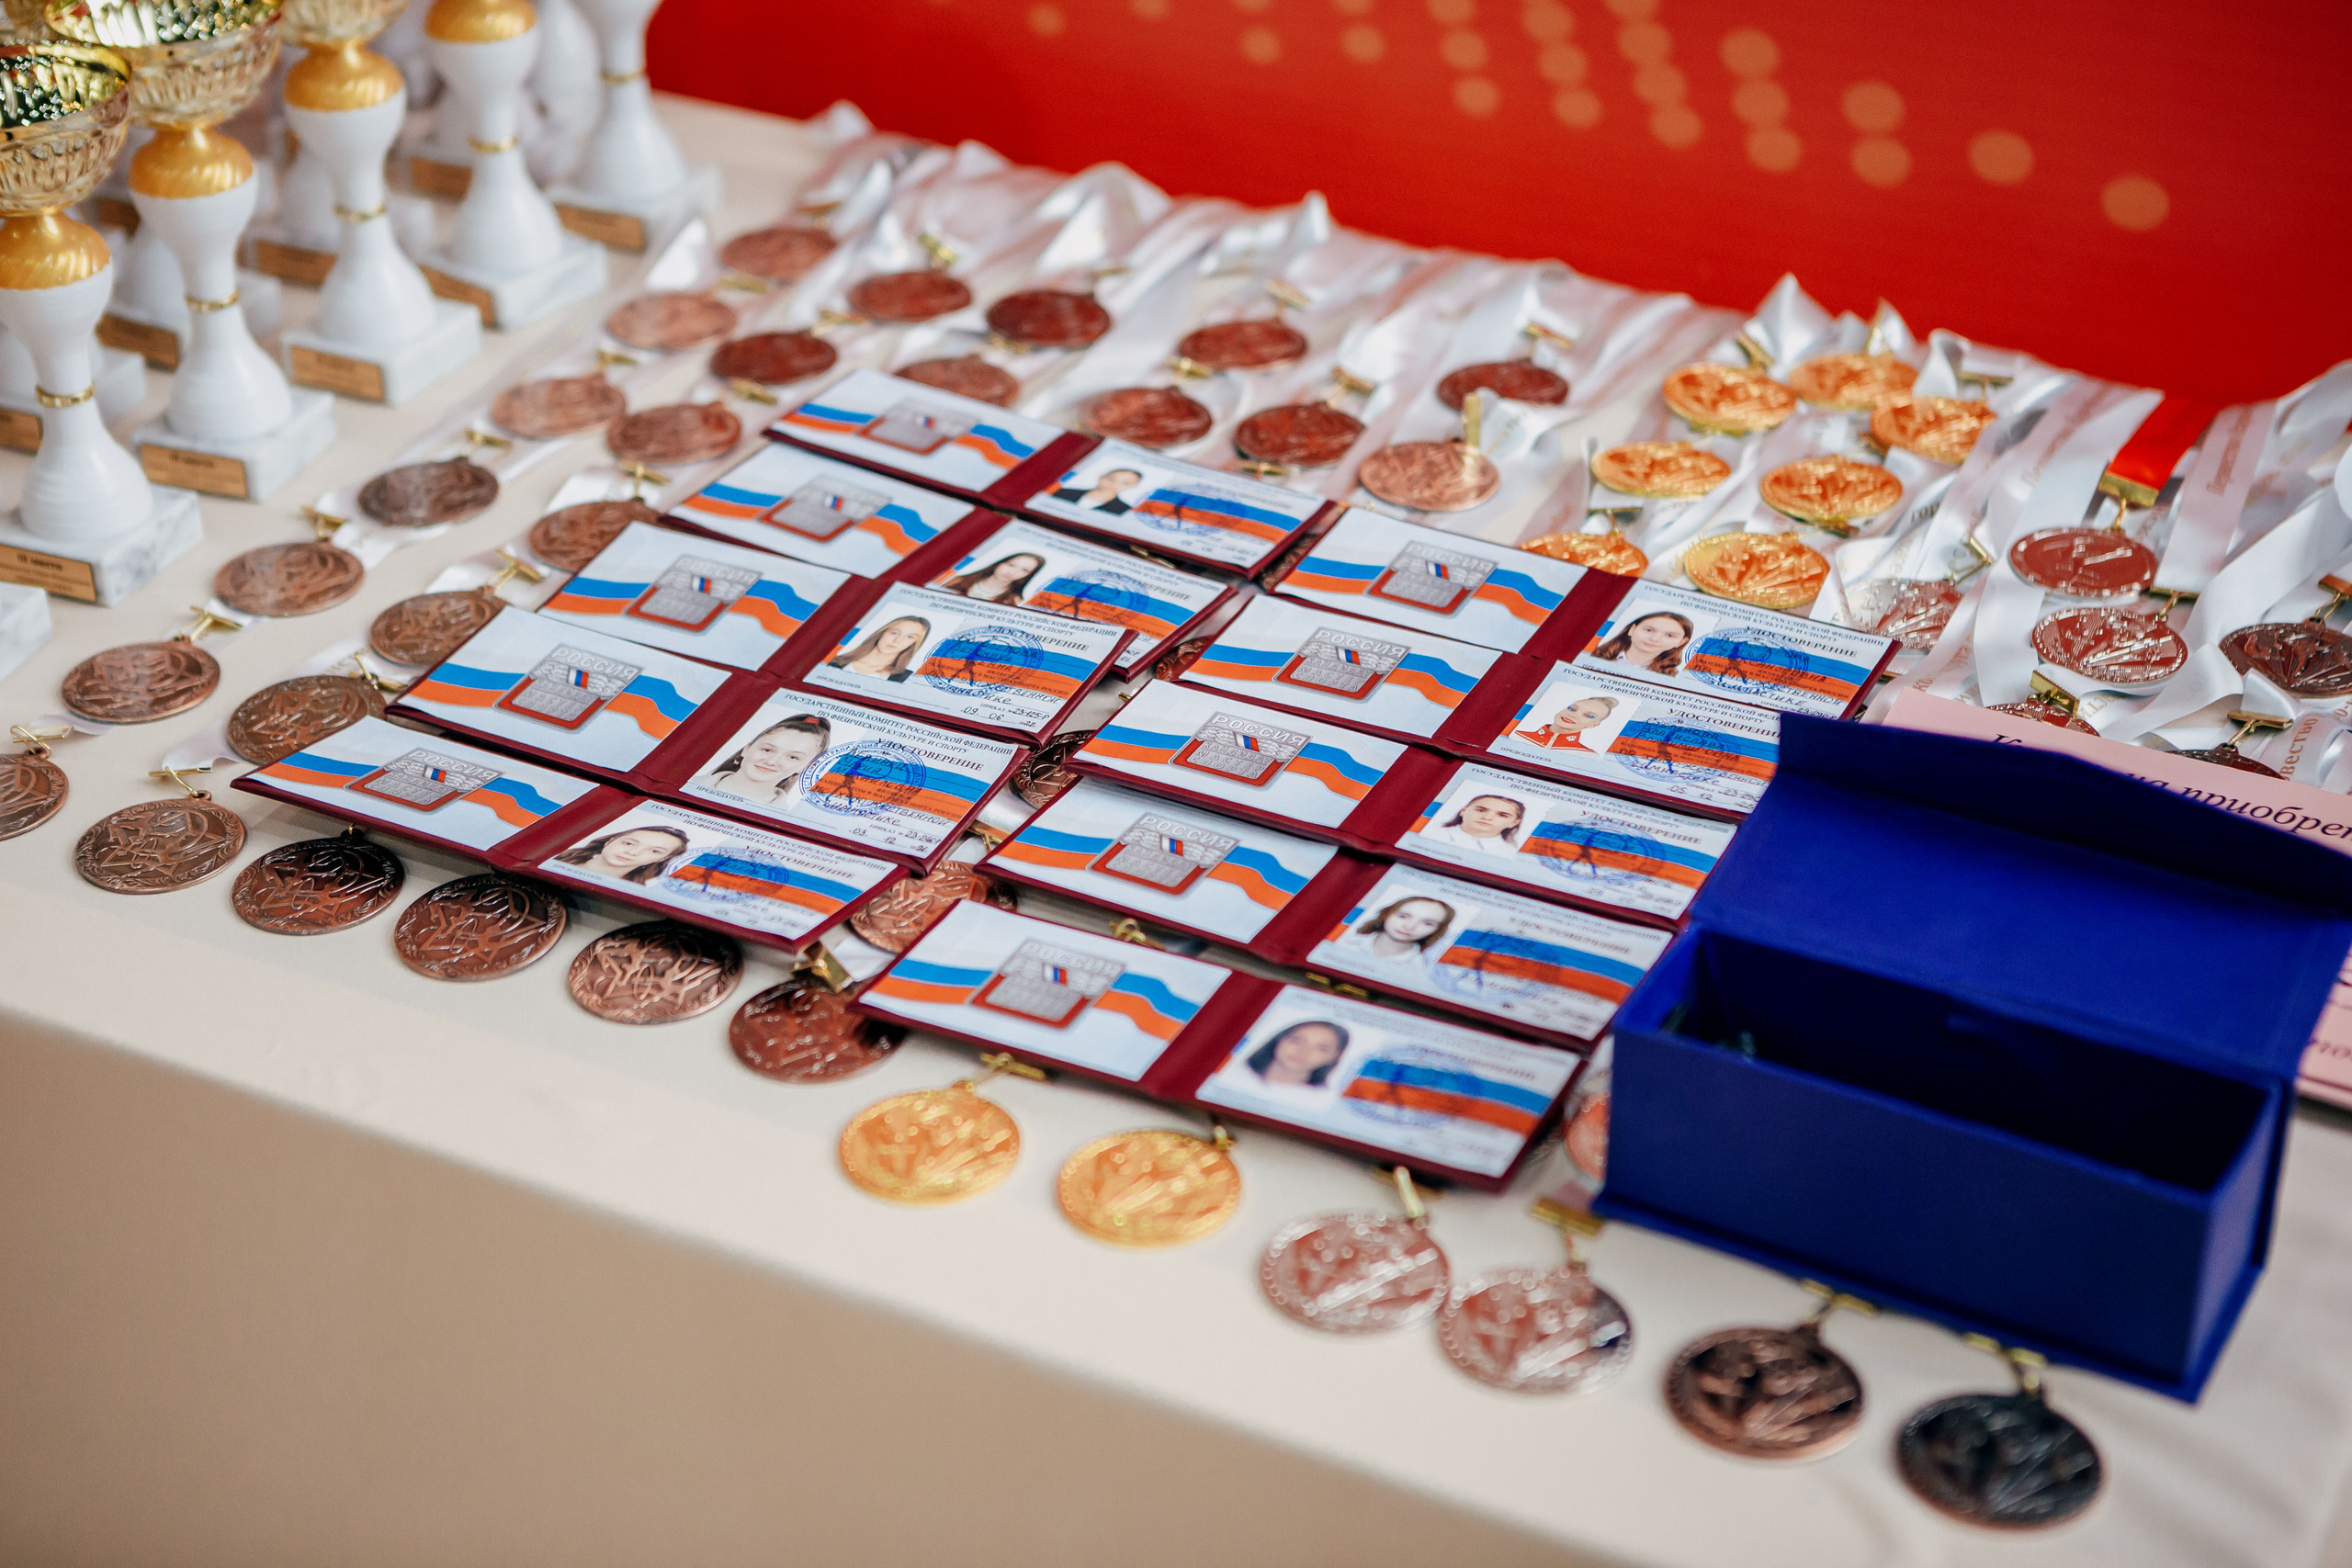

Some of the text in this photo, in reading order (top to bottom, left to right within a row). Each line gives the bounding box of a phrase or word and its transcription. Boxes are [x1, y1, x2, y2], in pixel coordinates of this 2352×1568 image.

[1407, 544, 1493, 572] РОССИЯ
[897, 589, 1118, 637] ГОСУДАРСТВЕННЫЙ КОМИТЕТ РОССИЙСКОЙ ФЕДЕРАЦИИ
[941, 604, 996, 620] ФИЗИЧЕСКОЙ
[994, 615, 1036, 628] КУЛЬТУРЕ
[1042, 626, 1075, 637] СПОРТУ
[1728, 606, 1770, 619] КОМИТЕТ
[1770, 615, 1831, 634] РОССИЙСКОЙ
[1829, 629, 1884, 647] ФЕДЕРАЦИИ
[983, 625, 1091, 651] УДОСТОВЕРЕНИЕ
[1314, 630, 1407, 658] РОССИЯ
[1743, 626, 1858, 658] УДОСТОВЕРЕНИЕ
[1802, 630, 1839, 643] СПОРТУ
[551, 647, 639, 681] РОССИЯ
[1298, 665, 1365, 684] МАСТЕР
[1306, 657, 1372, 677] КАНДИДАТ
[1293, 672, 1359, 693] СПОРТА
[1561, 669, 1650, 692] ГОСУДАРСТВЕННЫЙ
[1649, 688, 1693, 701] КОМИТЕТ
[1693, 698, 1757, 716] РОССИЙСКОЙ
[514, 697, 576, 721] СПОРТА
[523, 690, 589, 711] МАСТЕР
[1612, 687, 1675, 704] ФИЗИЧЕСКОЙ
[1674, 701, 1719, 714] КУЛЬТУРЕ
[1727, 712, 1765, 724] СПОРТУ
[783, 694, 1013, 756] ГОСУДАРСТВЕННЫЙ КОМИТЕТ РОССИЙСКОЙ ФЕДЕРАЦИИ
[828, 713, 888, 732] ФИЗИЧЕСКОЙ
[884, 728, 929, 743] КУЛЬТУРЕ
[933, 740, 970, 754] СПОРТУ
[1211, 715, 1307, 746] РОССИЯ
[1666, 707, 1783, 739] УДОСТОВЕРЕНИ
[872, 738, 985, 771] УДОСТОВЕРЕНИЕ
[1195, 750, 1266, 771] МАСТЕР
[1204, 741, 1274, 764] КАНДИДАТ
[1498, 747, 1554, 762] ПРЕДСЕДАТЕЛЬ
[2279, 717, 2318, 781] вество
[408, 750, 499, 781] РОССИЯ
[1191, 756, 1258, 779] СПОРТА
[368, 784, 431, 805] СПОРТА
[695, 785, 746, 803] ПРЕДСЕДАТЕЛЬ
[1469, 767, 1562, 793] ГОСУДАРСТВЕННЫЙ
[1561, 790, 1606, 804] КОМИТЕТ
[648, 804, 736, 829] ГОСУДАРСТВЕННЫЙ
[732, 827, 776, 841] КОМИТЕТ
[1138, 815, 1236, 851] РОССИЯ
[1579, 810, 1703, 844] УДОСТОВЕРЕНИЕ
[741, 845, 856, 879] УДОСТОВЕРЕНИЕ
[1021, 941, 1122, 978] РОССИЯ
